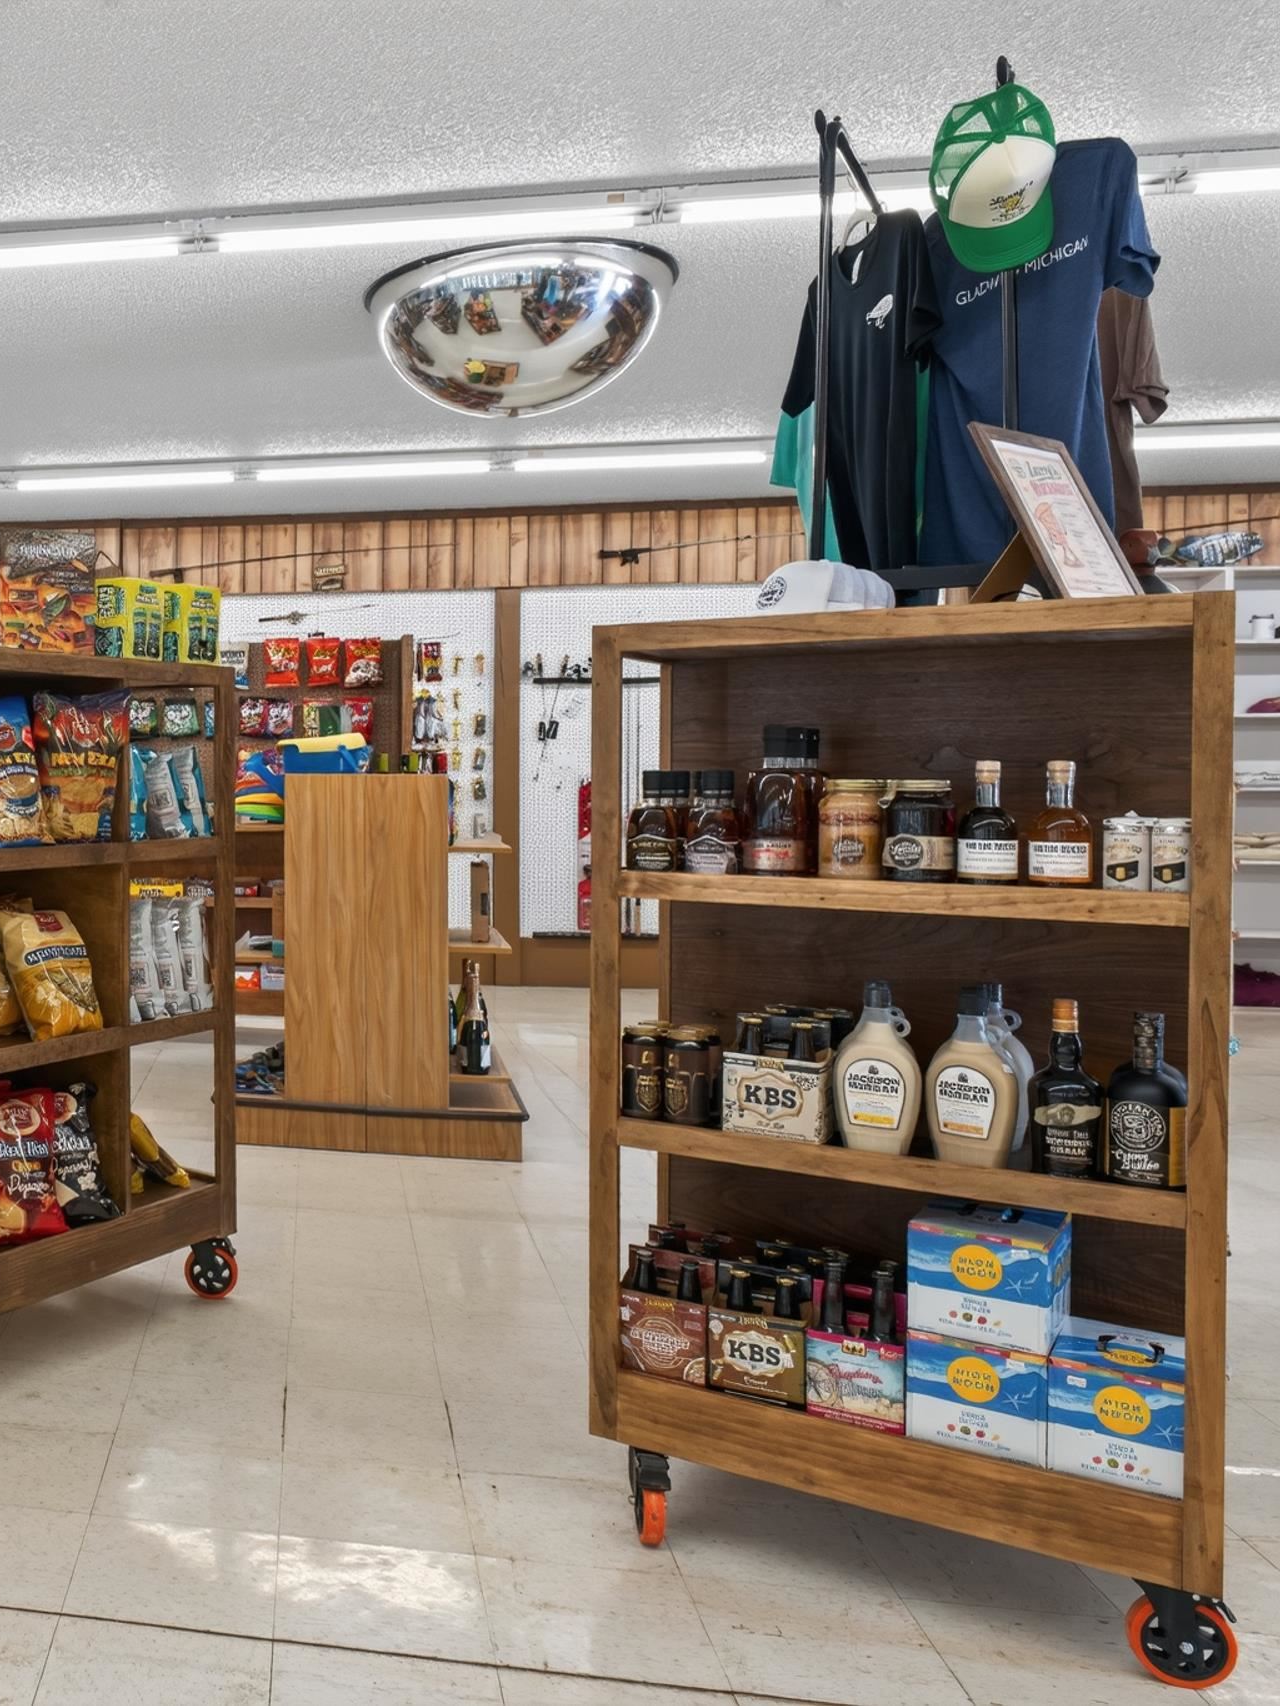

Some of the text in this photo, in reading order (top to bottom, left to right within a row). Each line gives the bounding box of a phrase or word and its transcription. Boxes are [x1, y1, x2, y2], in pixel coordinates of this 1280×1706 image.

[1024, 235, 1089, 273] MICHIGAN
[744, 1084, 797, 1109] KBS
[728, 1339, 781, 1366] KBS
